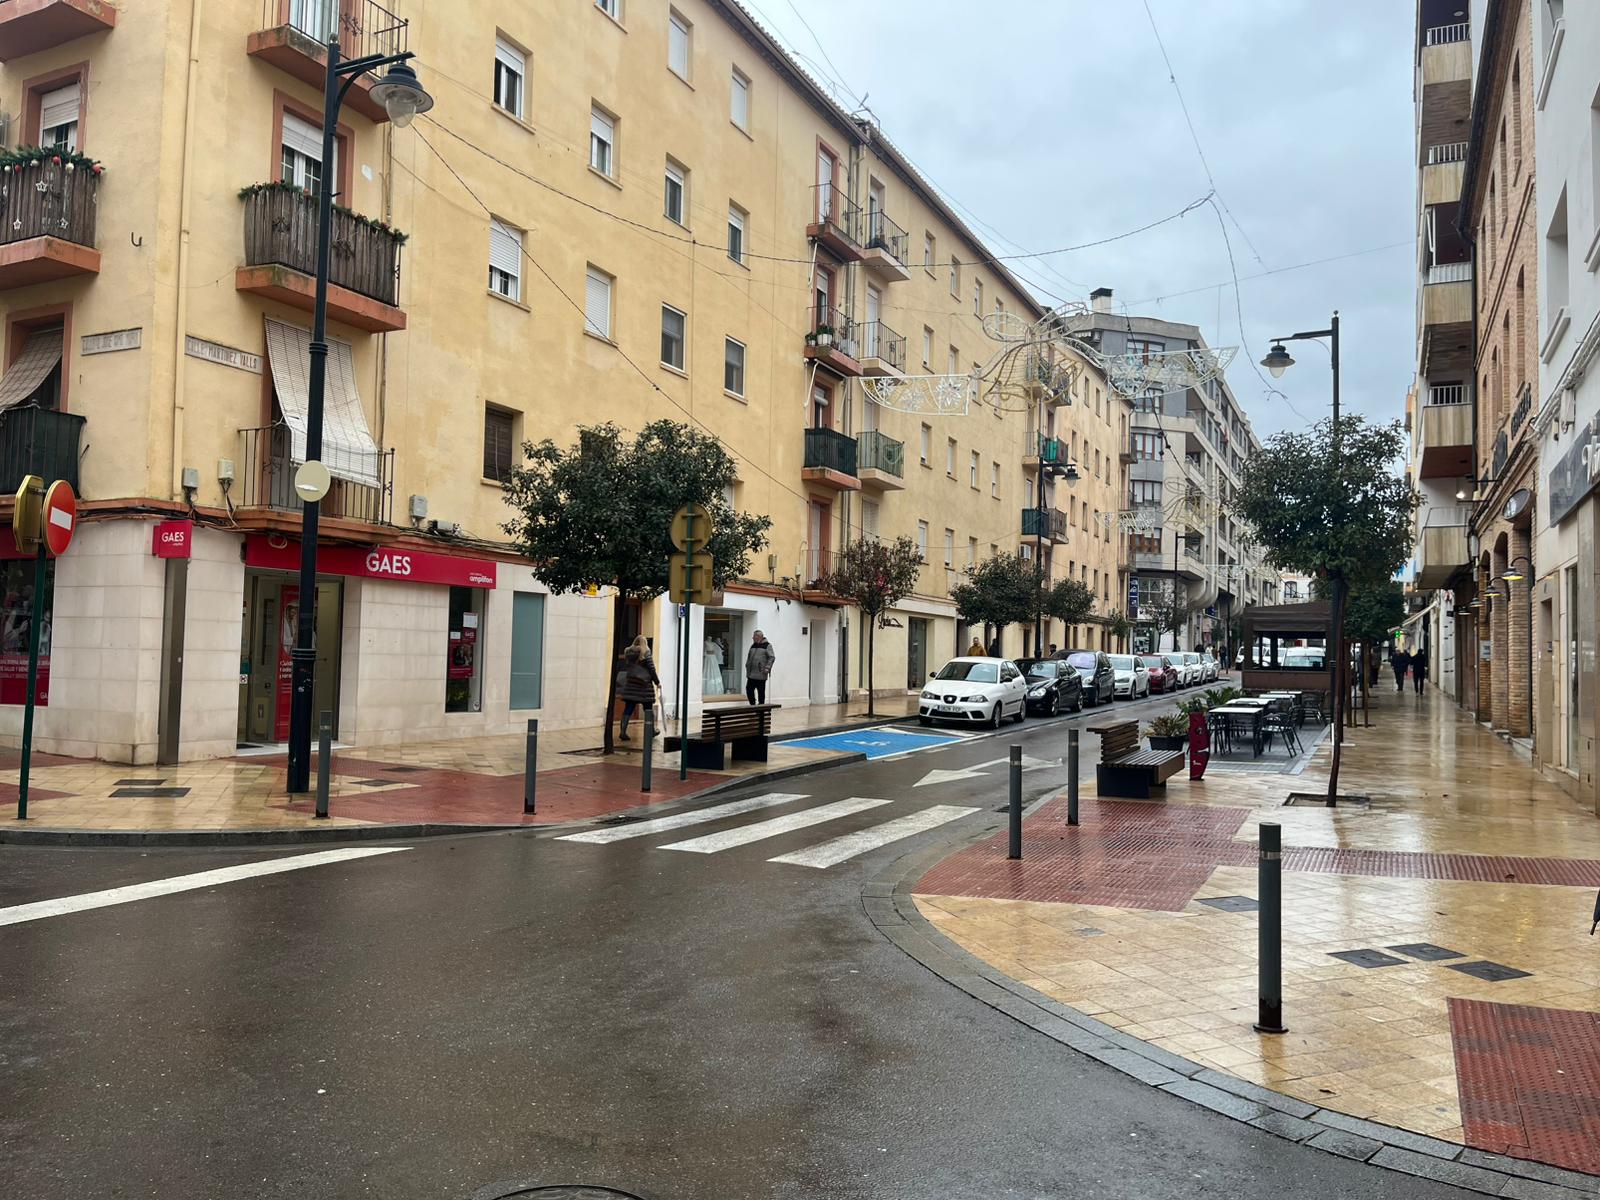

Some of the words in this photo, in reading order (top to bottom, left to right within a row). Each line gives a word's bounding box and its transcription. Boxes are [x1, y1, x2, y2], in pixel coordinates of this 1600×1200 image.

[207, 345, 237, 364] MARTINEZ
[240, 353, 257, 369] VALLS
[161, 531, 185, 543] GAES
[366, 552, 411, 575] GAES
[469, 575, 493, 584] amplifon
